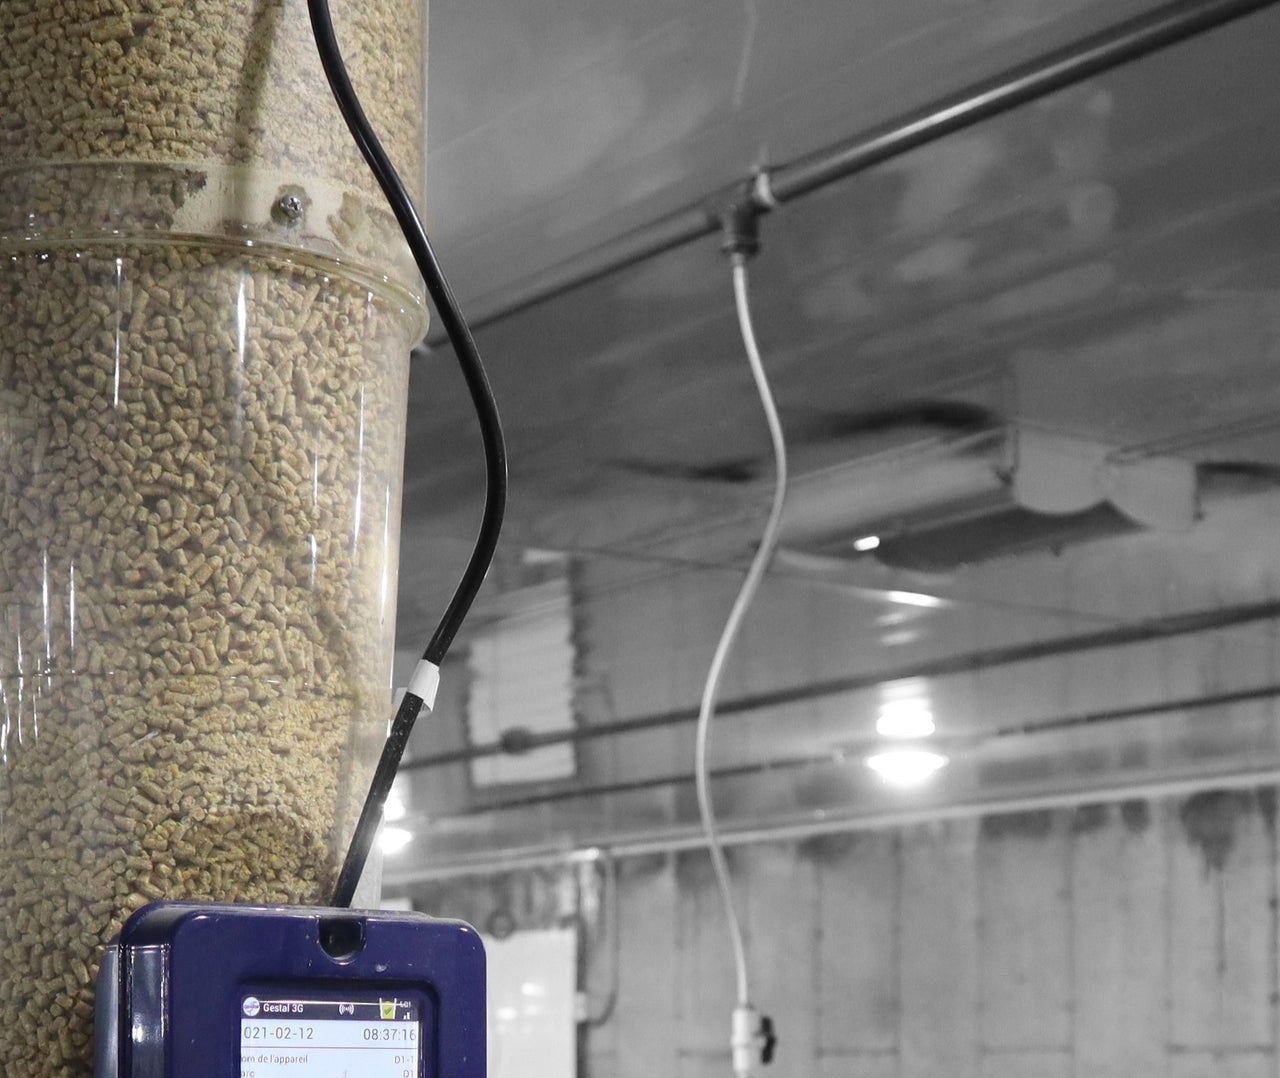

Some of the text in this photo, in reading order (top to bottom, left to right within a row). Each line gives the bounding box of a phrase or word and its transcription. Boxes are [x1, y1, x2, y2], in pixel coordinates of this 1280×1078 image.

[263, 1003, 290, 1012] Gestal
[291, 1003, 304, 1013] 3G
[363, 1028, 417, 1041] 08:37:16
[257, 1054, 268, 1063] de
[270, 1054, 308, 1065] l'appareil
